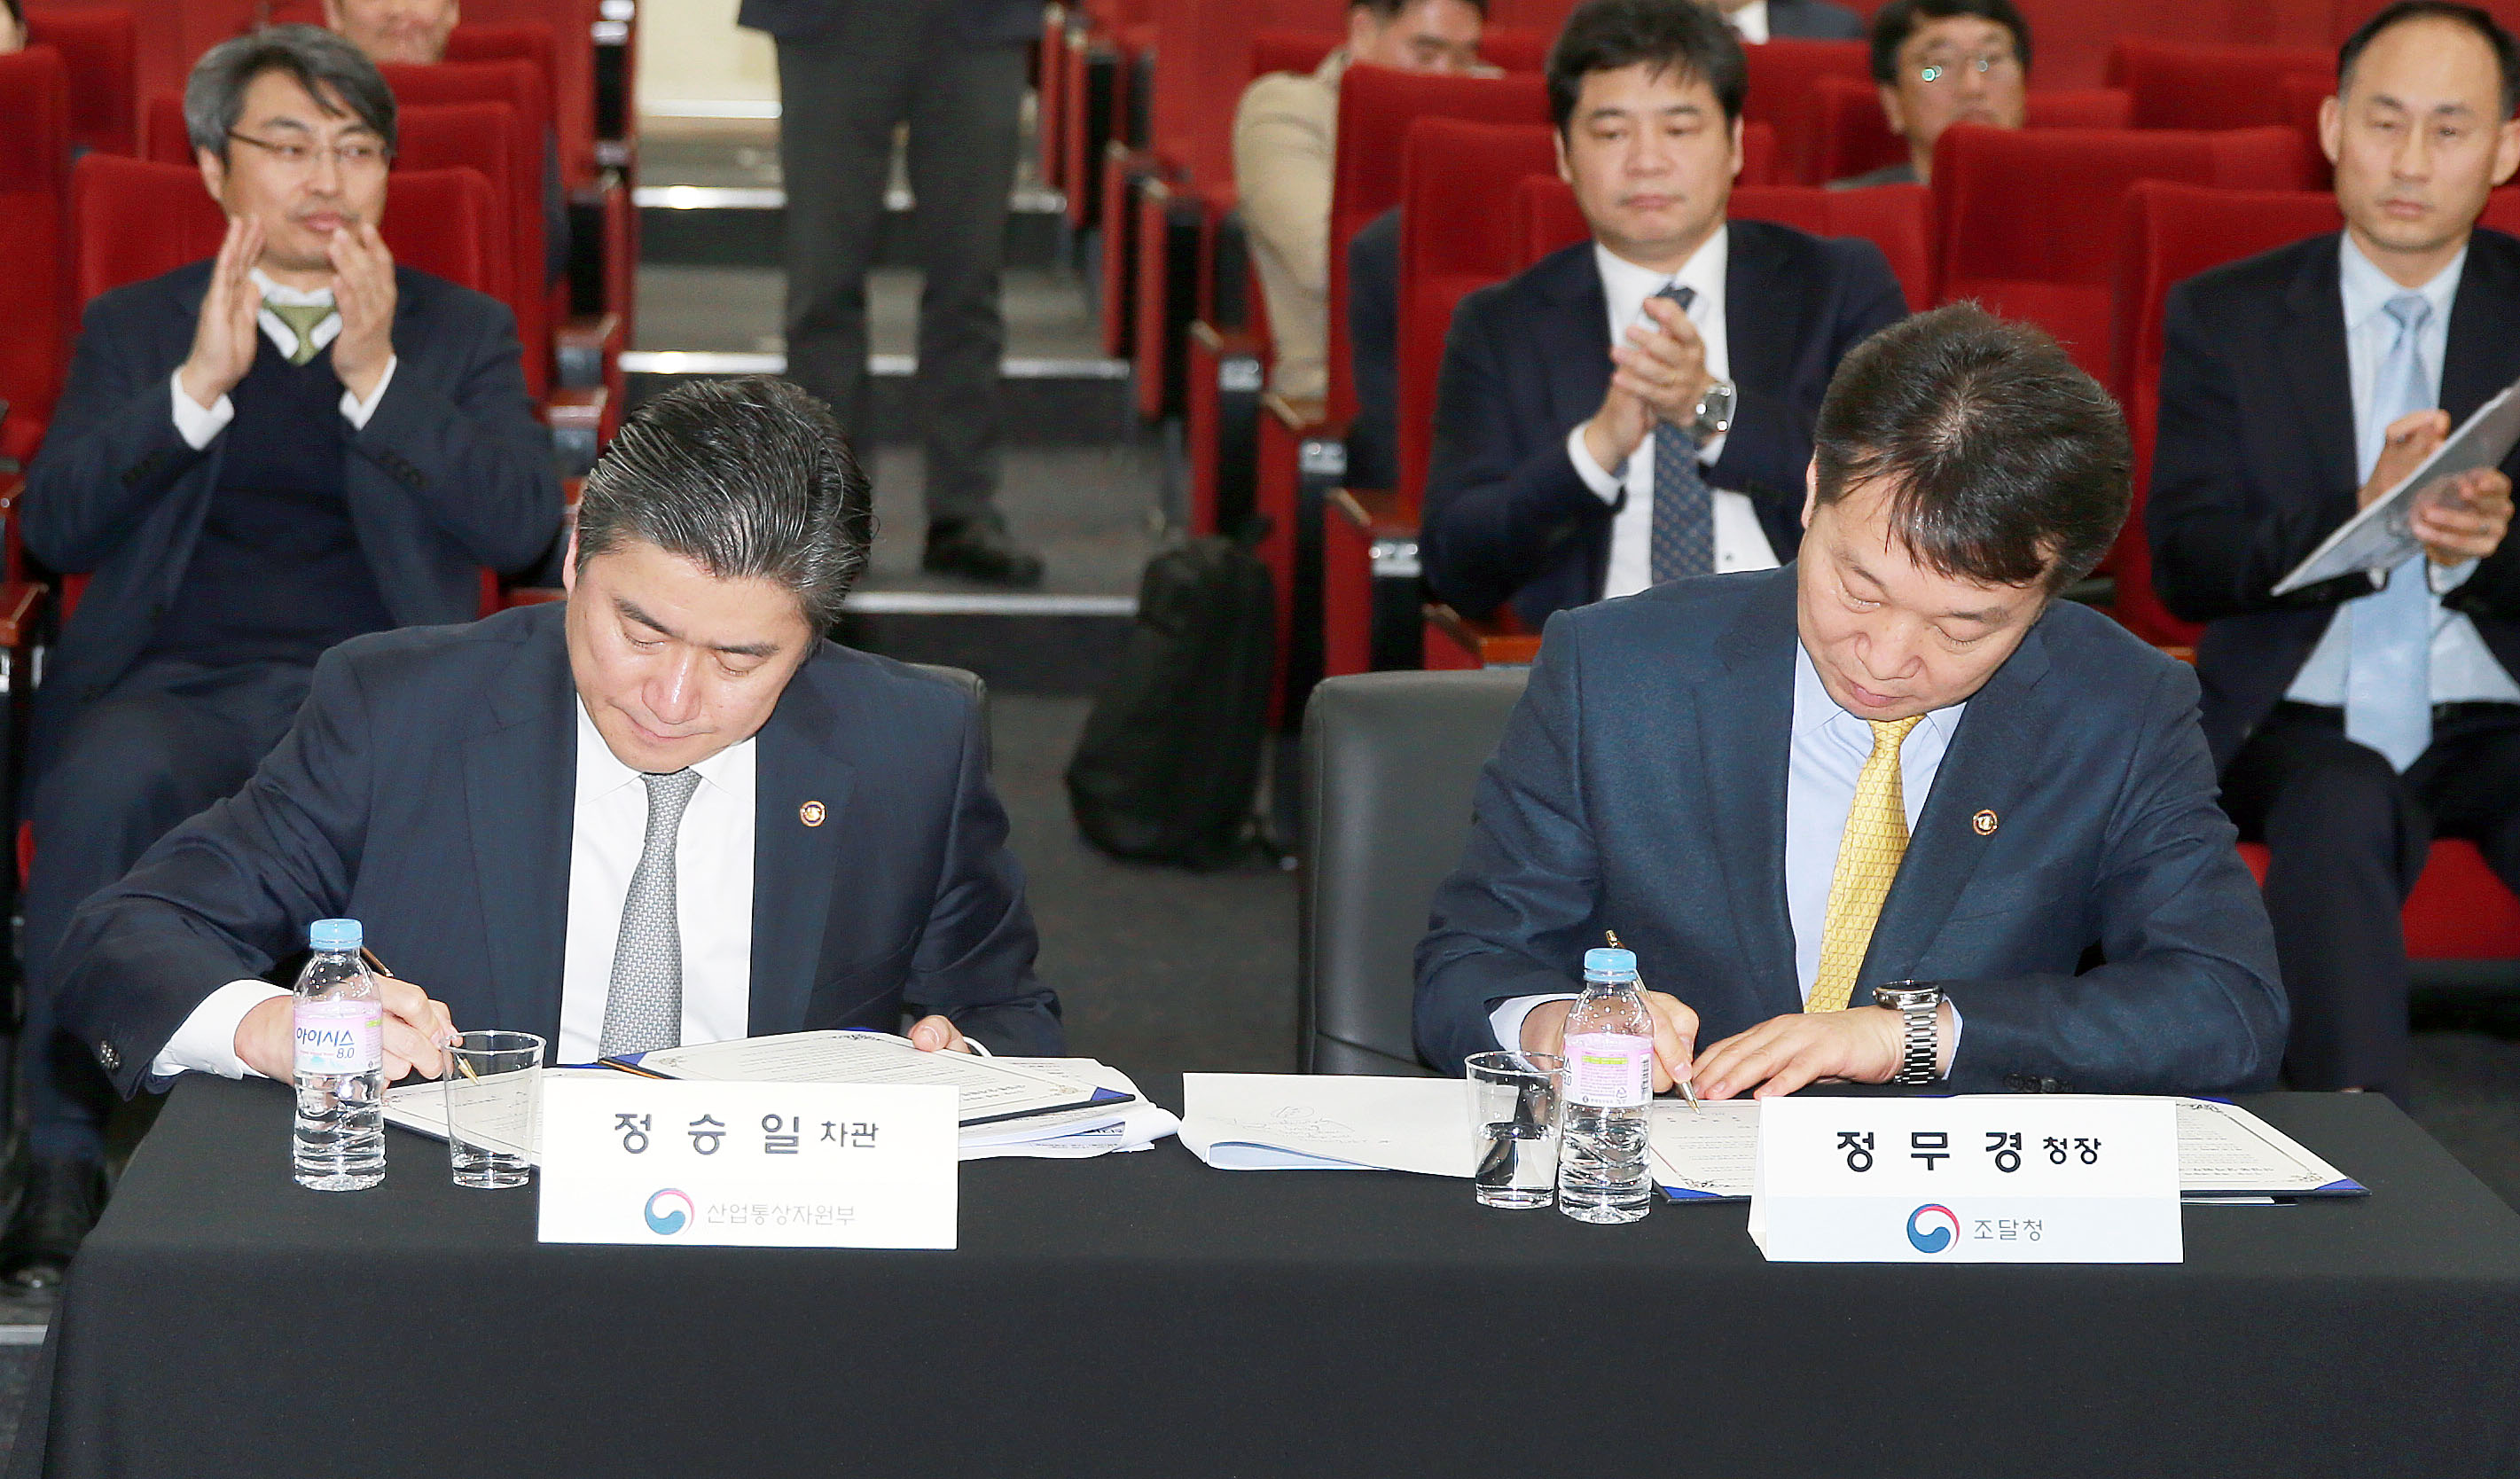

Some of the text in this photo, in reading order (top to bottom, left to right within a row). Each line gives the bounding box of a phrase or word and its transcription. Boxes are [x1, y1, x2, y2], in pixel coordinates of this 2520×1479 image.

[296, 1027, 355, 1046] 아이시스
[336, 1047, 355, 1059] 8.0
[820, 1120, 880, 1148] 차관
[2043, 1136, 2102, 1165] 청장
[707, 1202, 857, 1226] 산업통상자원부
[1973, 1218, 2044, 1242] 조달청
